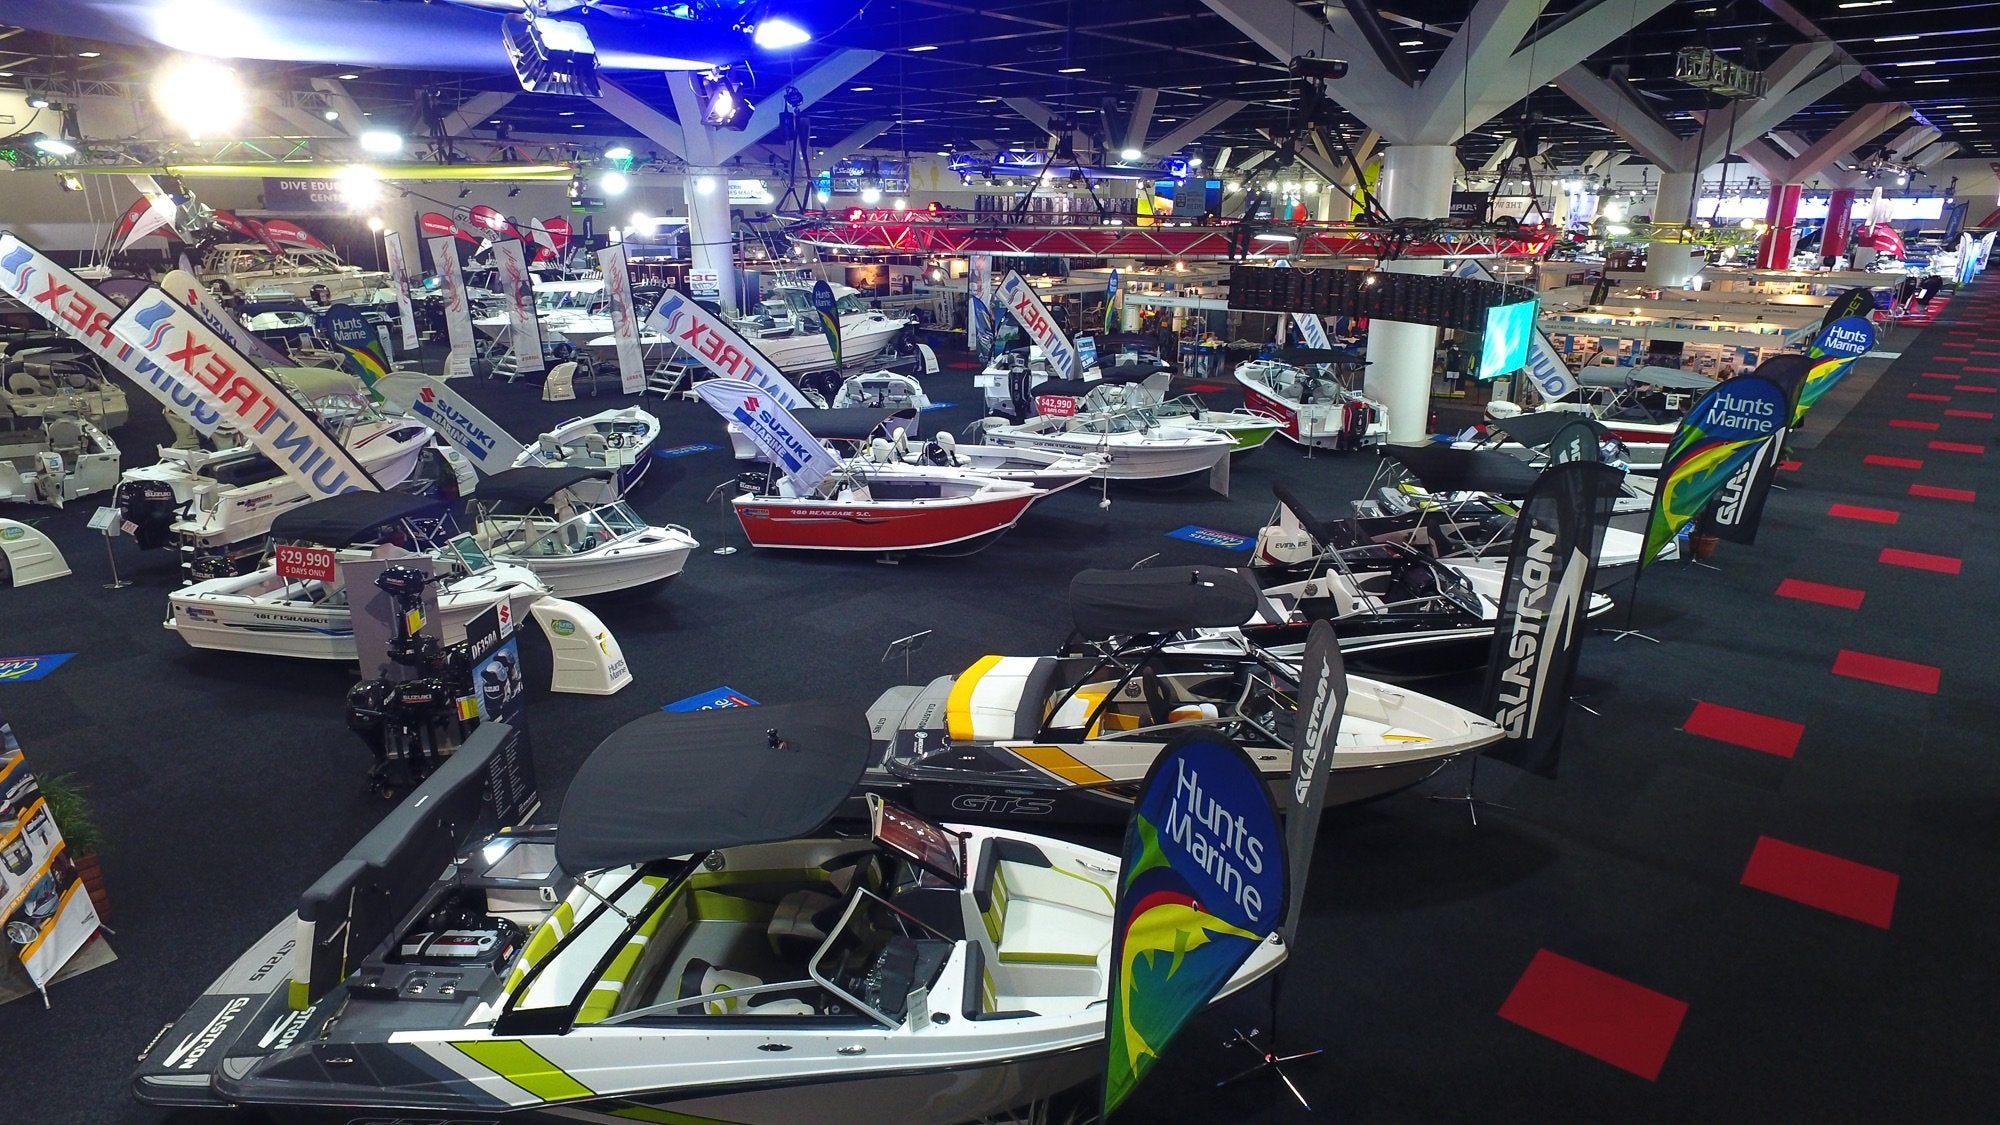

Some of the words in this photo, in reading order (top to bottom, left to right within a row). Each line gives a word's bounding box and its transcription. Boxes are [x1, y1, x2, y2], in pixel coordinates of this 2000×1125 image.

[280, 181, 307, 190] DIVE
[815, 290, 831, 299] Hunts
[332, 318, 362, 331] Hunts
[1830, 326, 1867, 343] Hunts
[333, 329, 366, 342] Marine
[1825, 337, 1865, 354] Marine
[1041, 398, 1072, 409] $42,990
[1713, 392, 1774, 416] Hunts
[431, 411, 471, 447] MARINE
[436, 399, 496, 449] SUZUKI
[1706, 412, 1773, 433] Marine
[749, 421, 786, 458] MARINE
[758, 410, 813, 463] SUZUKI
[280, 551, 330, 568] $29,990
[291, 567, 307, 575] DAYS
[309, 568, 326, 578] ONLY
[1495, 528, 1558, 739] GLASTRON
[471, 630, 498, 660] DF350A
[608, 660, 624, 673] Hunts
[609, 667, 627, 681] Marine
[951, 794, 1056, 815] GTS
[1176, 757, 1264, 876] Hunts
[1165, 798, 1263, 922] Marine
[249, 938, 297, 982] GT205
[178, 997, 250, 1070] GLASTRON
